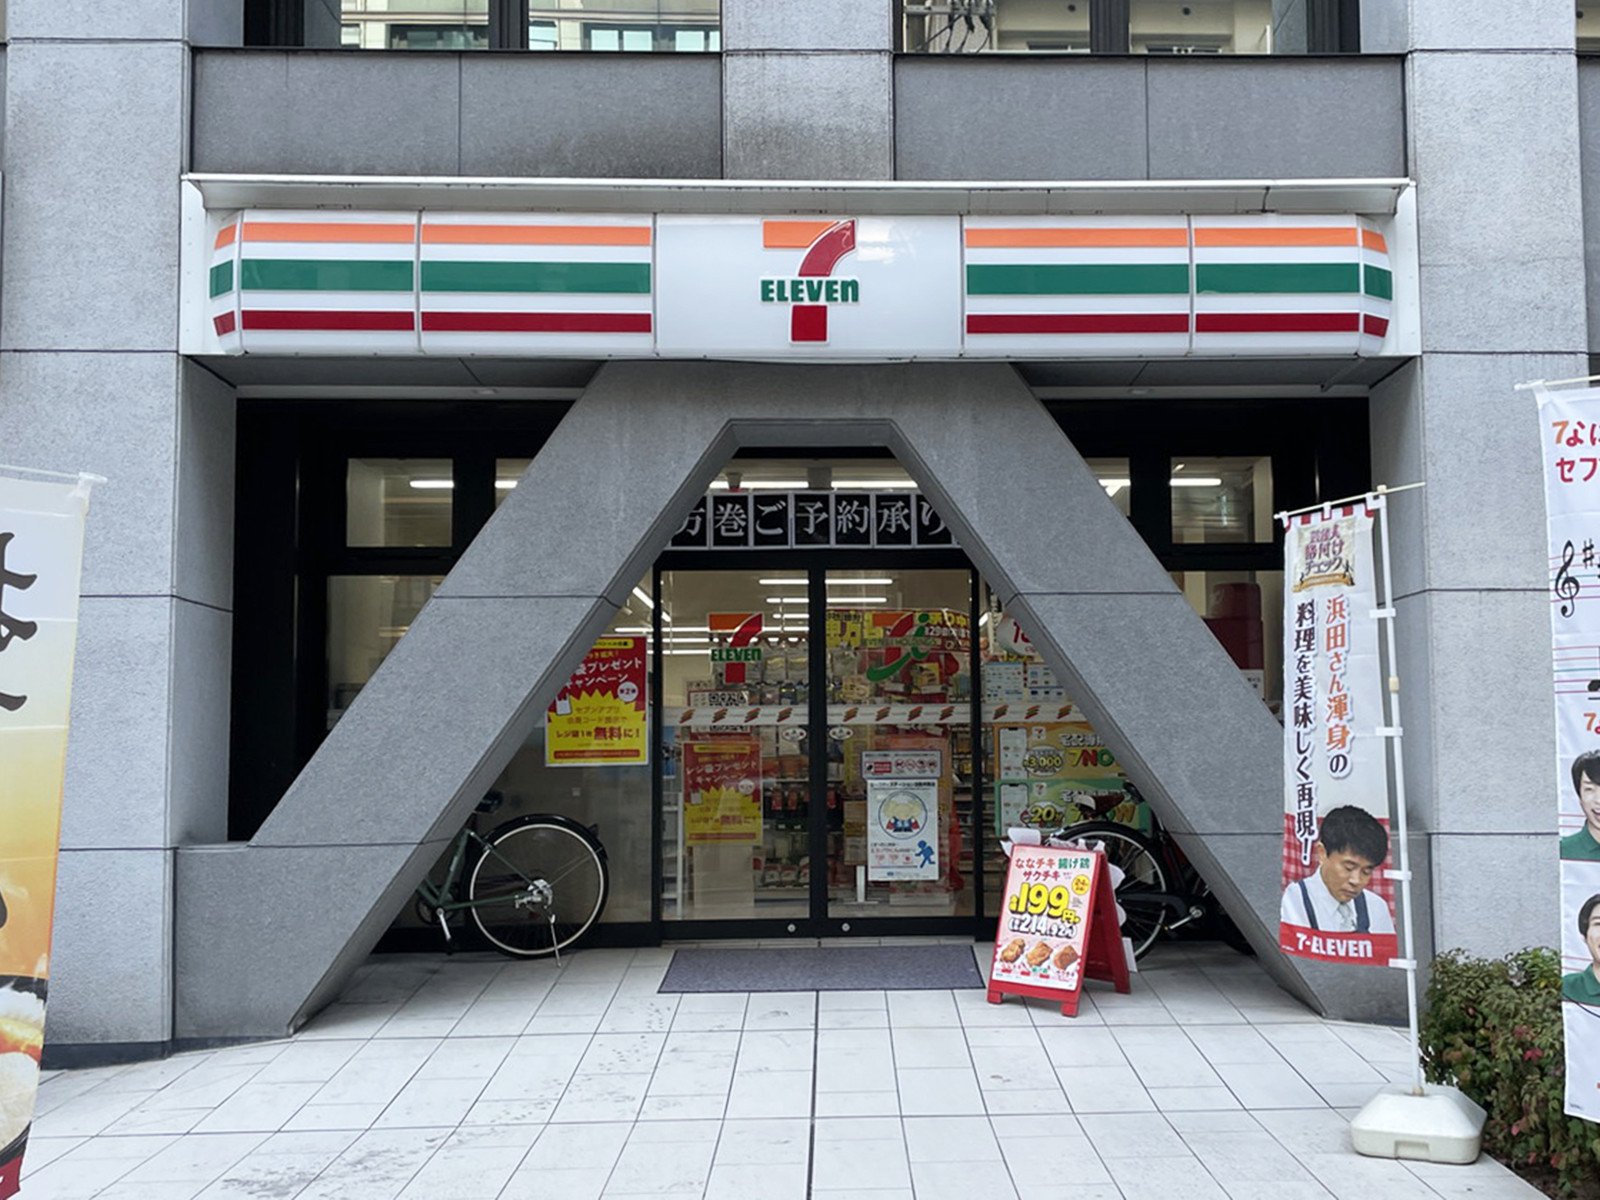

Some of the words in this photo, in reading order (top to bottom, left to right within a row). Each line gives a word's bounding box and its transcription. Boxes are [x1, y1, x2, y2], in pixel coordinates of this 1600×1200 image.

[1325, 594, 1350, 774] 浜田さん渾身の
[1016, 858, 1055, 869] ななチキ
[1023, 870, 1060, 881] サクチキ
